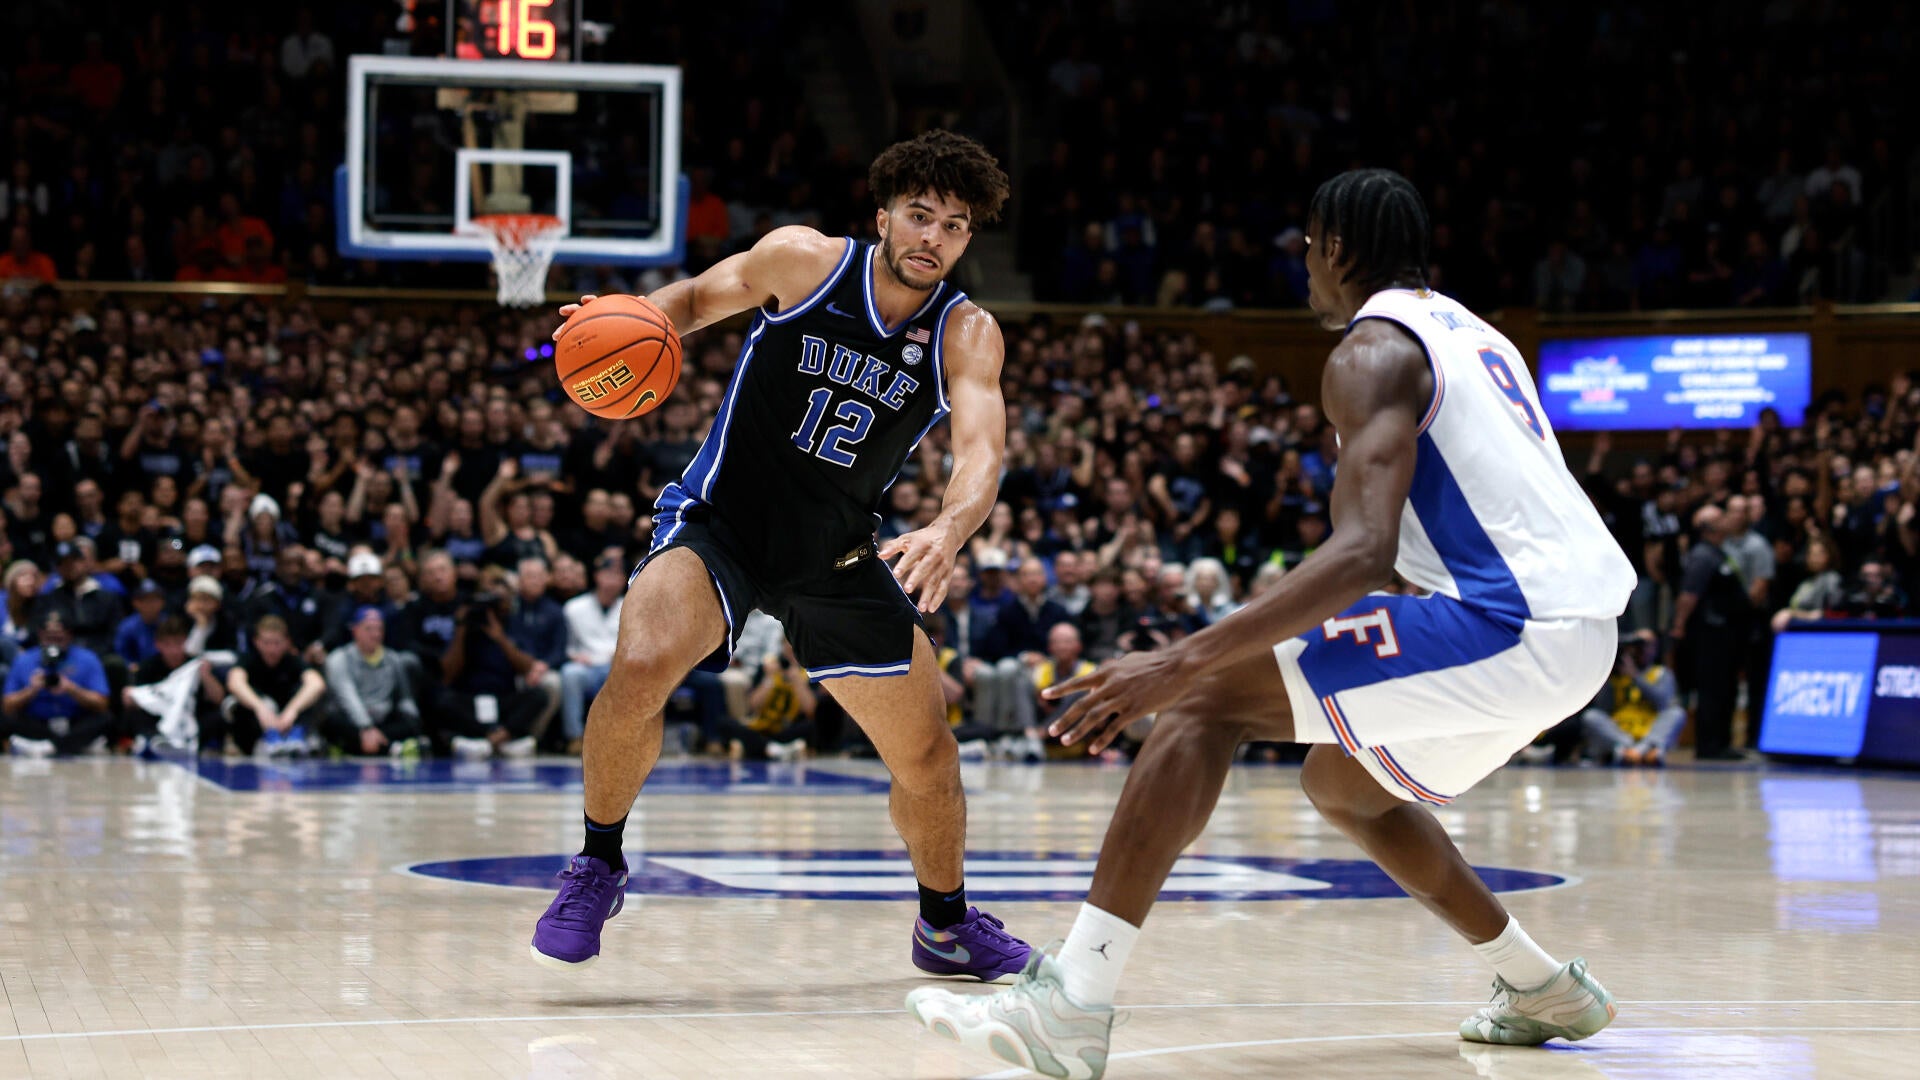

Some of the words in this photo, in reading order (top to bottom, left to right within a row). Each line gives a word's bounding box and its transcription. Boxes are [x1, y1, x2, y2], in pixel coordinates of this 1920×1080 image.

[498, 0, 556, 59] 16
[575, 364, 636, 404] ELITE
[798, 334, 920, 411] DUKE
[1478, 347, 1546, 441] 9
[791, 387, 875, 468] 12
[1322, 607, 1402, 660] F
